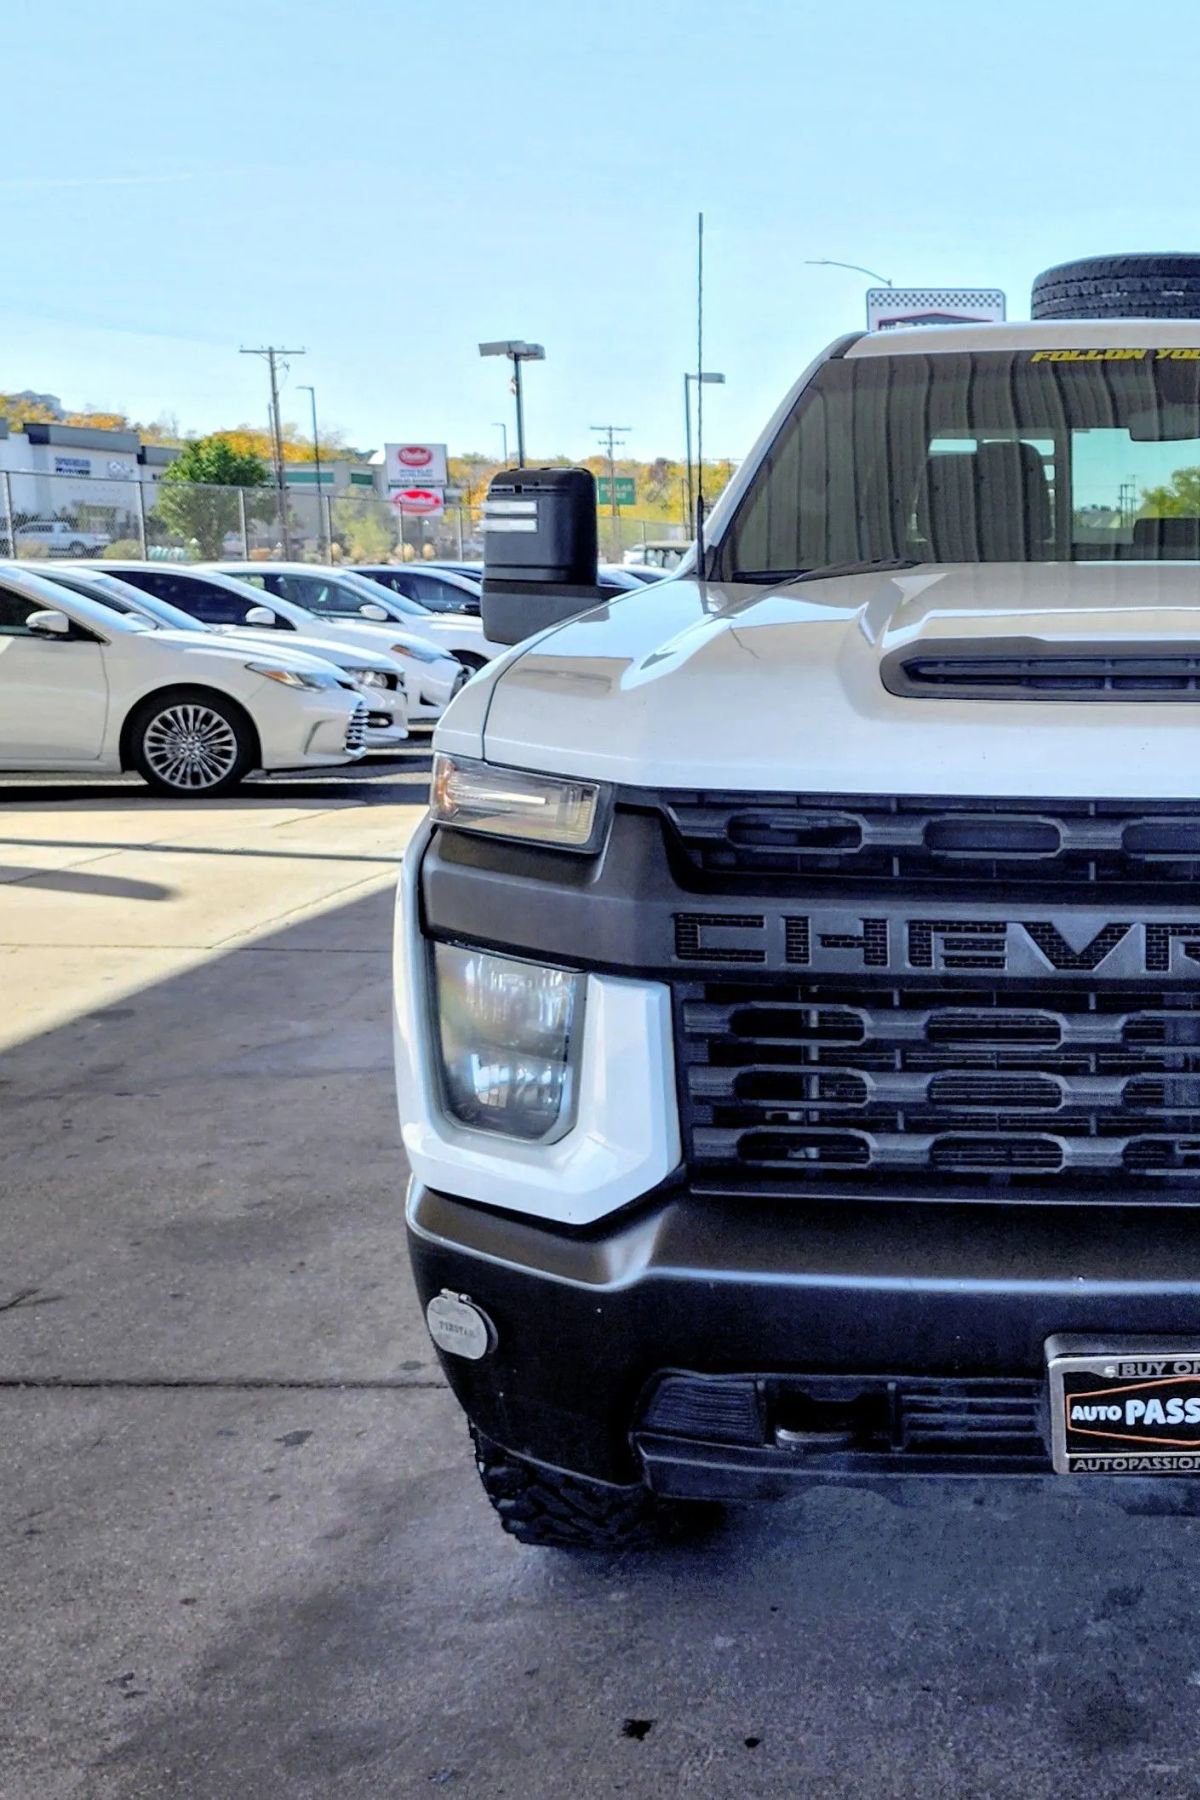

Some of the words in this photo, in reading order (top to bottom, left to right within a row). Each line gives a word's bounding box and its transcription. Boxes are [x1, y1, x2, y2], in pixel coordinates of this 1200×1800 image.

[1031, 350, 1147, 362] FOLLOW
[1121, 1362, 1166, 1376] BUY
[1071, 1405, 1122, 1421] AUTO
